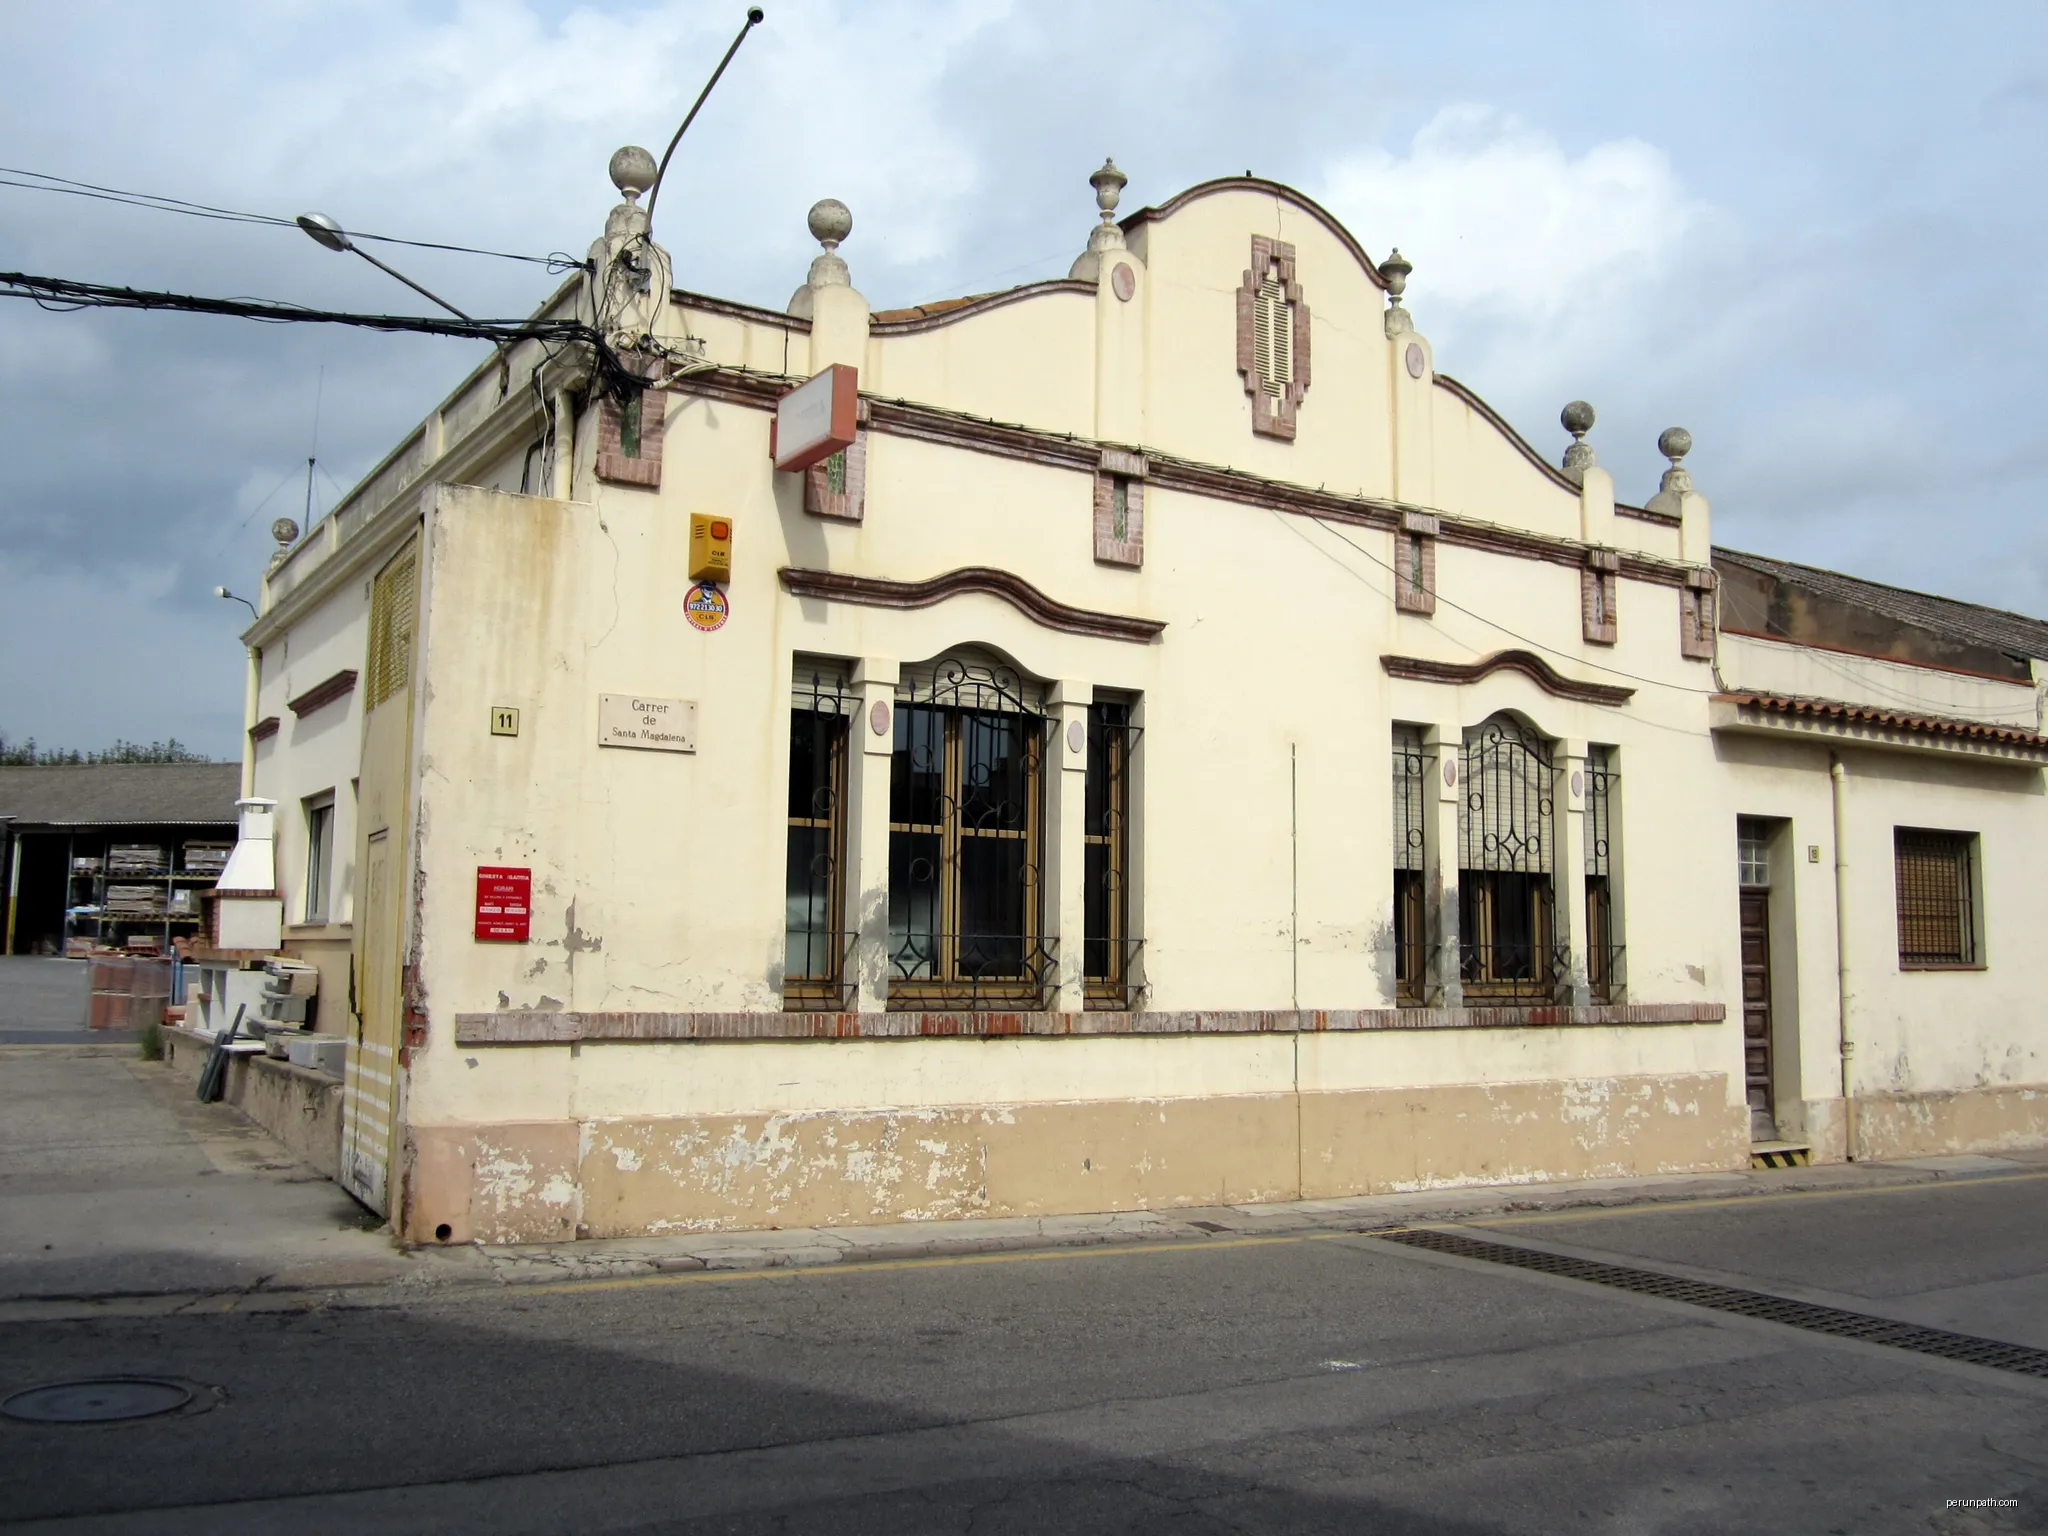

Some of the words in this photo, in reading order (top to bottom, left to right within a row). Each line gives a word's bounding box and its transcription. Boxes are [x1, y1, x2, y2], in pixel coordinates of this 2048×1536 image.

[632, 699, 669, 713] Carrer
[498, 713, 512, 728] 11
[642, 715, 656, 725] de
[612, 727, 637, 738] Santa
[641, 729, 686, 742] Magdalena
